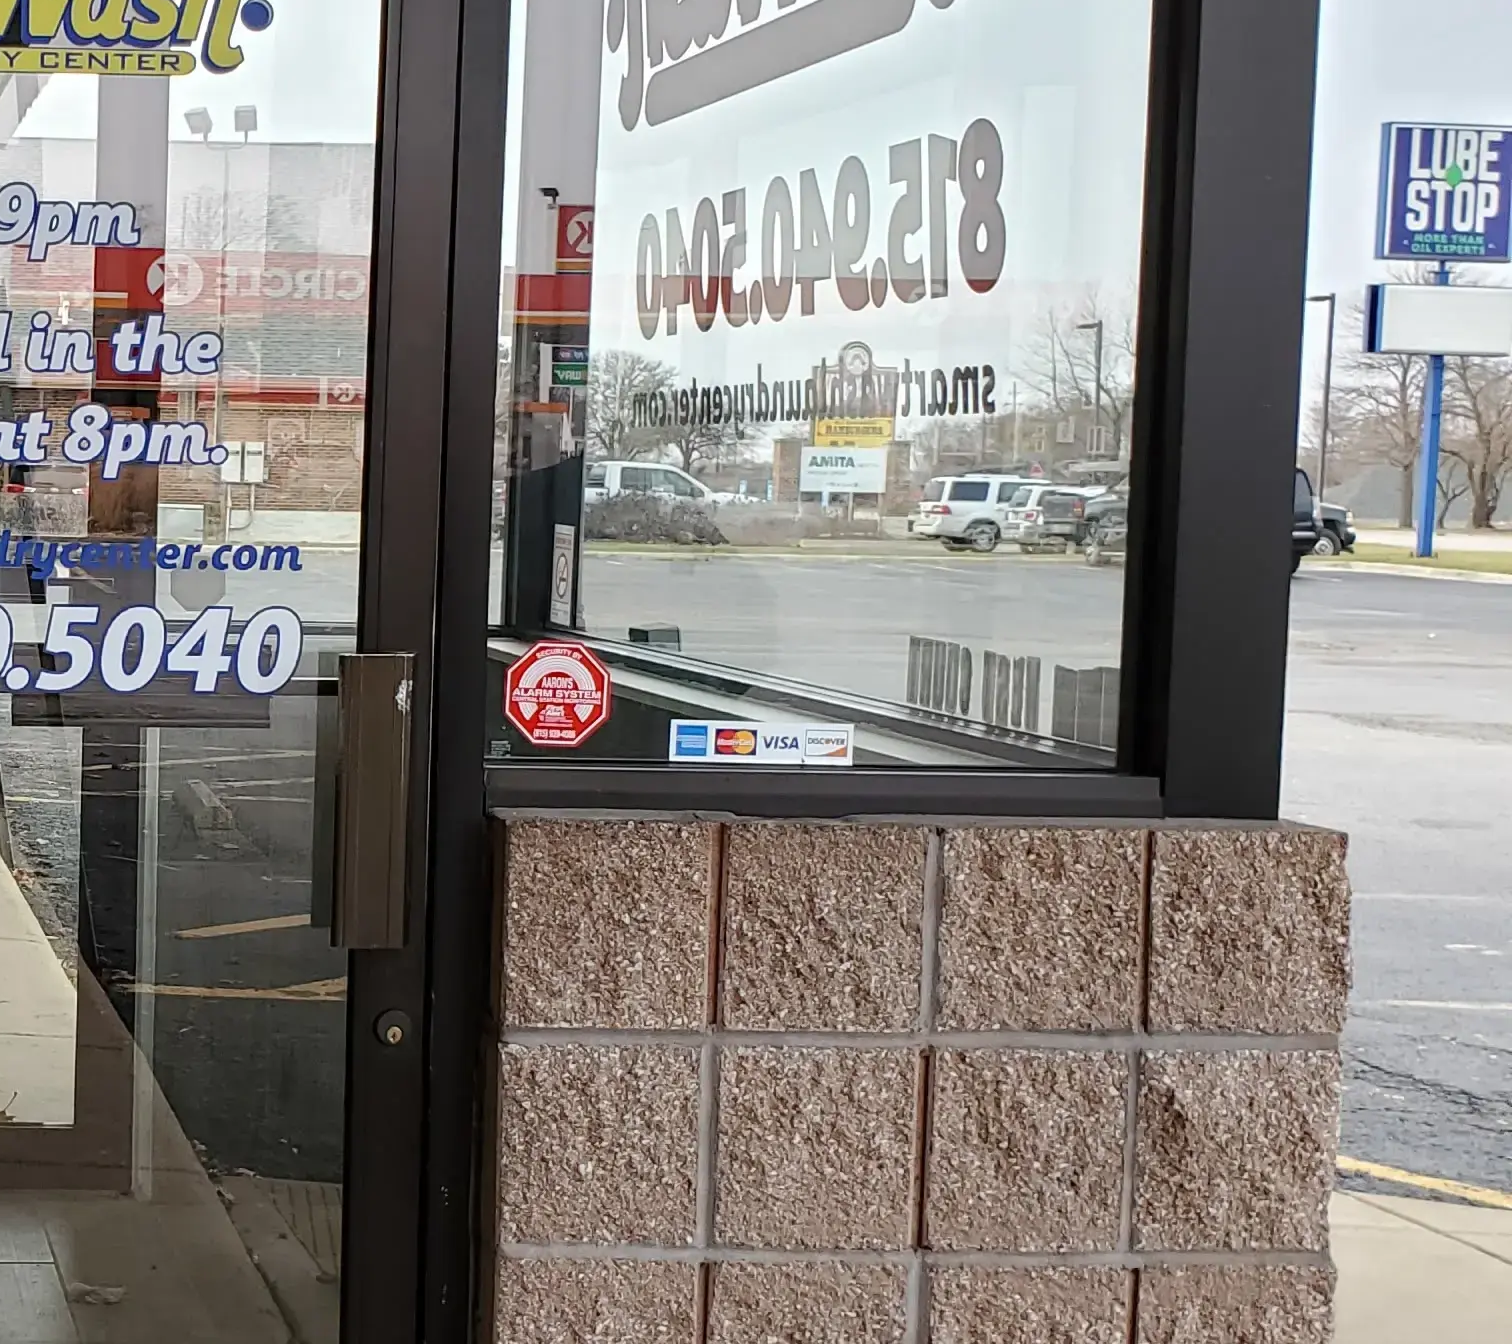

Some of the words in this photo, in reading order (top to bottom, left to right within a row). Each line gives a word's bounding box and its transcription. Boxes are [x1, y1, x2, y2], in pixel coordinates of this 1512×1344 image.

[40, 51, 181, 73] CENTER
[1409, 127, 1504, 182] LUBE
[1405, 179, 1500, 234] STOP
[1413, 233, 1448, 244] MORE
[1451, 234, 1485, 245] THAN
[1411, 243, 1431, 253] OIL
[1434, 244, 1486, 256] EXPERTS
[25, 310, 95, 374] in
[110, 312, 223, 376] the
[61, 403, 233, 482] 8pm.
[808, 455, 856, 468] AMITA
[535, 648, 573, 659] SECURITY
[572, 652, 583, 661] BY
[541, 676, 574, 689] AARON'S
[512, 687, 553, 697] ALARM
[555, 689, 602, 699] SYSTEM
[761, 735, 800, 751] VISA
[807, 737, 846, 747] DISCOVER
